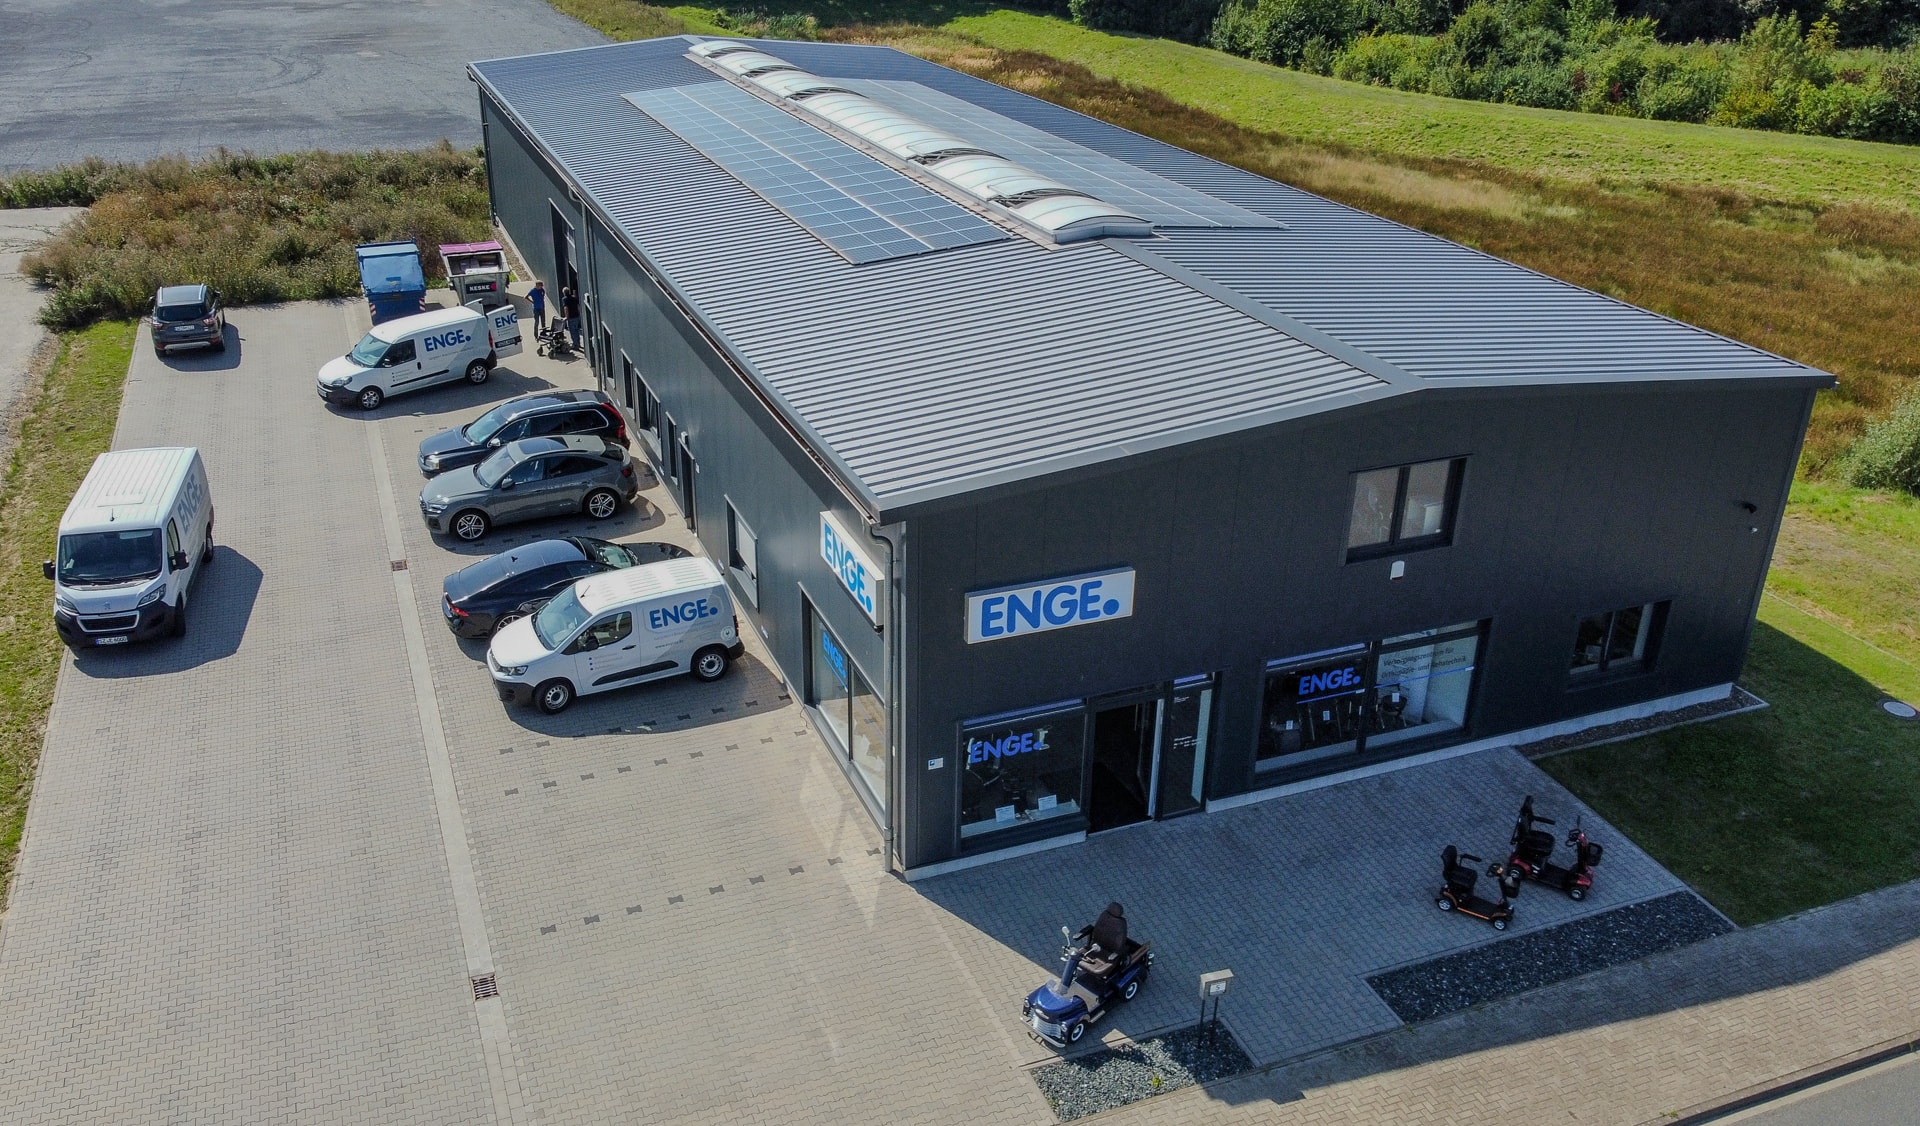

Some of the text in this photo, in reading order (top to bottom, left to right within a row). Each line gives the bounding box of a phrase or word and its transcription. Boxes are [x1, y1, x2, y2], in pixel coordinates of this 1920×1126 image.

[424, 329, 471, 352] ENGE.
[824, 522, 873, 614] ENGE.
[649, 598, 718, 630] ENGE.
[981, 580, 1120, 638] ENGE.
[1298, 667, 1361, 696] ENGE.
[970, 732, 1043, 764] ENGE.
